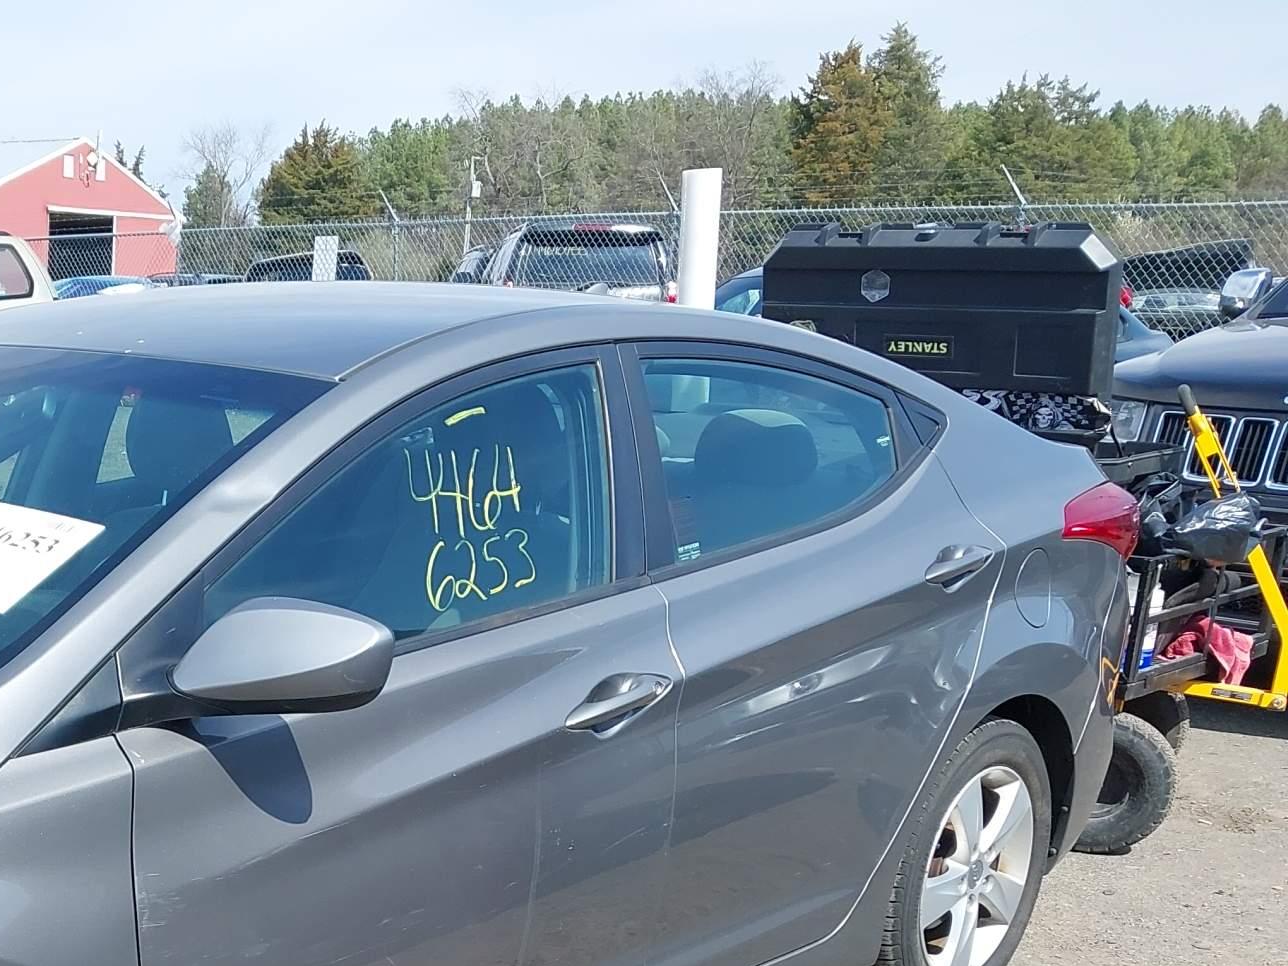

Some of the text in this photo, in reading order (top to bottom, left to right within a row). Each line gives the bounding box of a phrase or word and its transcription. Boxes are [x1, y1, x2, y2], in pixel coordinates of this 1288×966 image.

[888, 340, 948, 354] STANLEY
[402, 443, 522, 538] 4464
[423, 527, 538, 613] 6253
